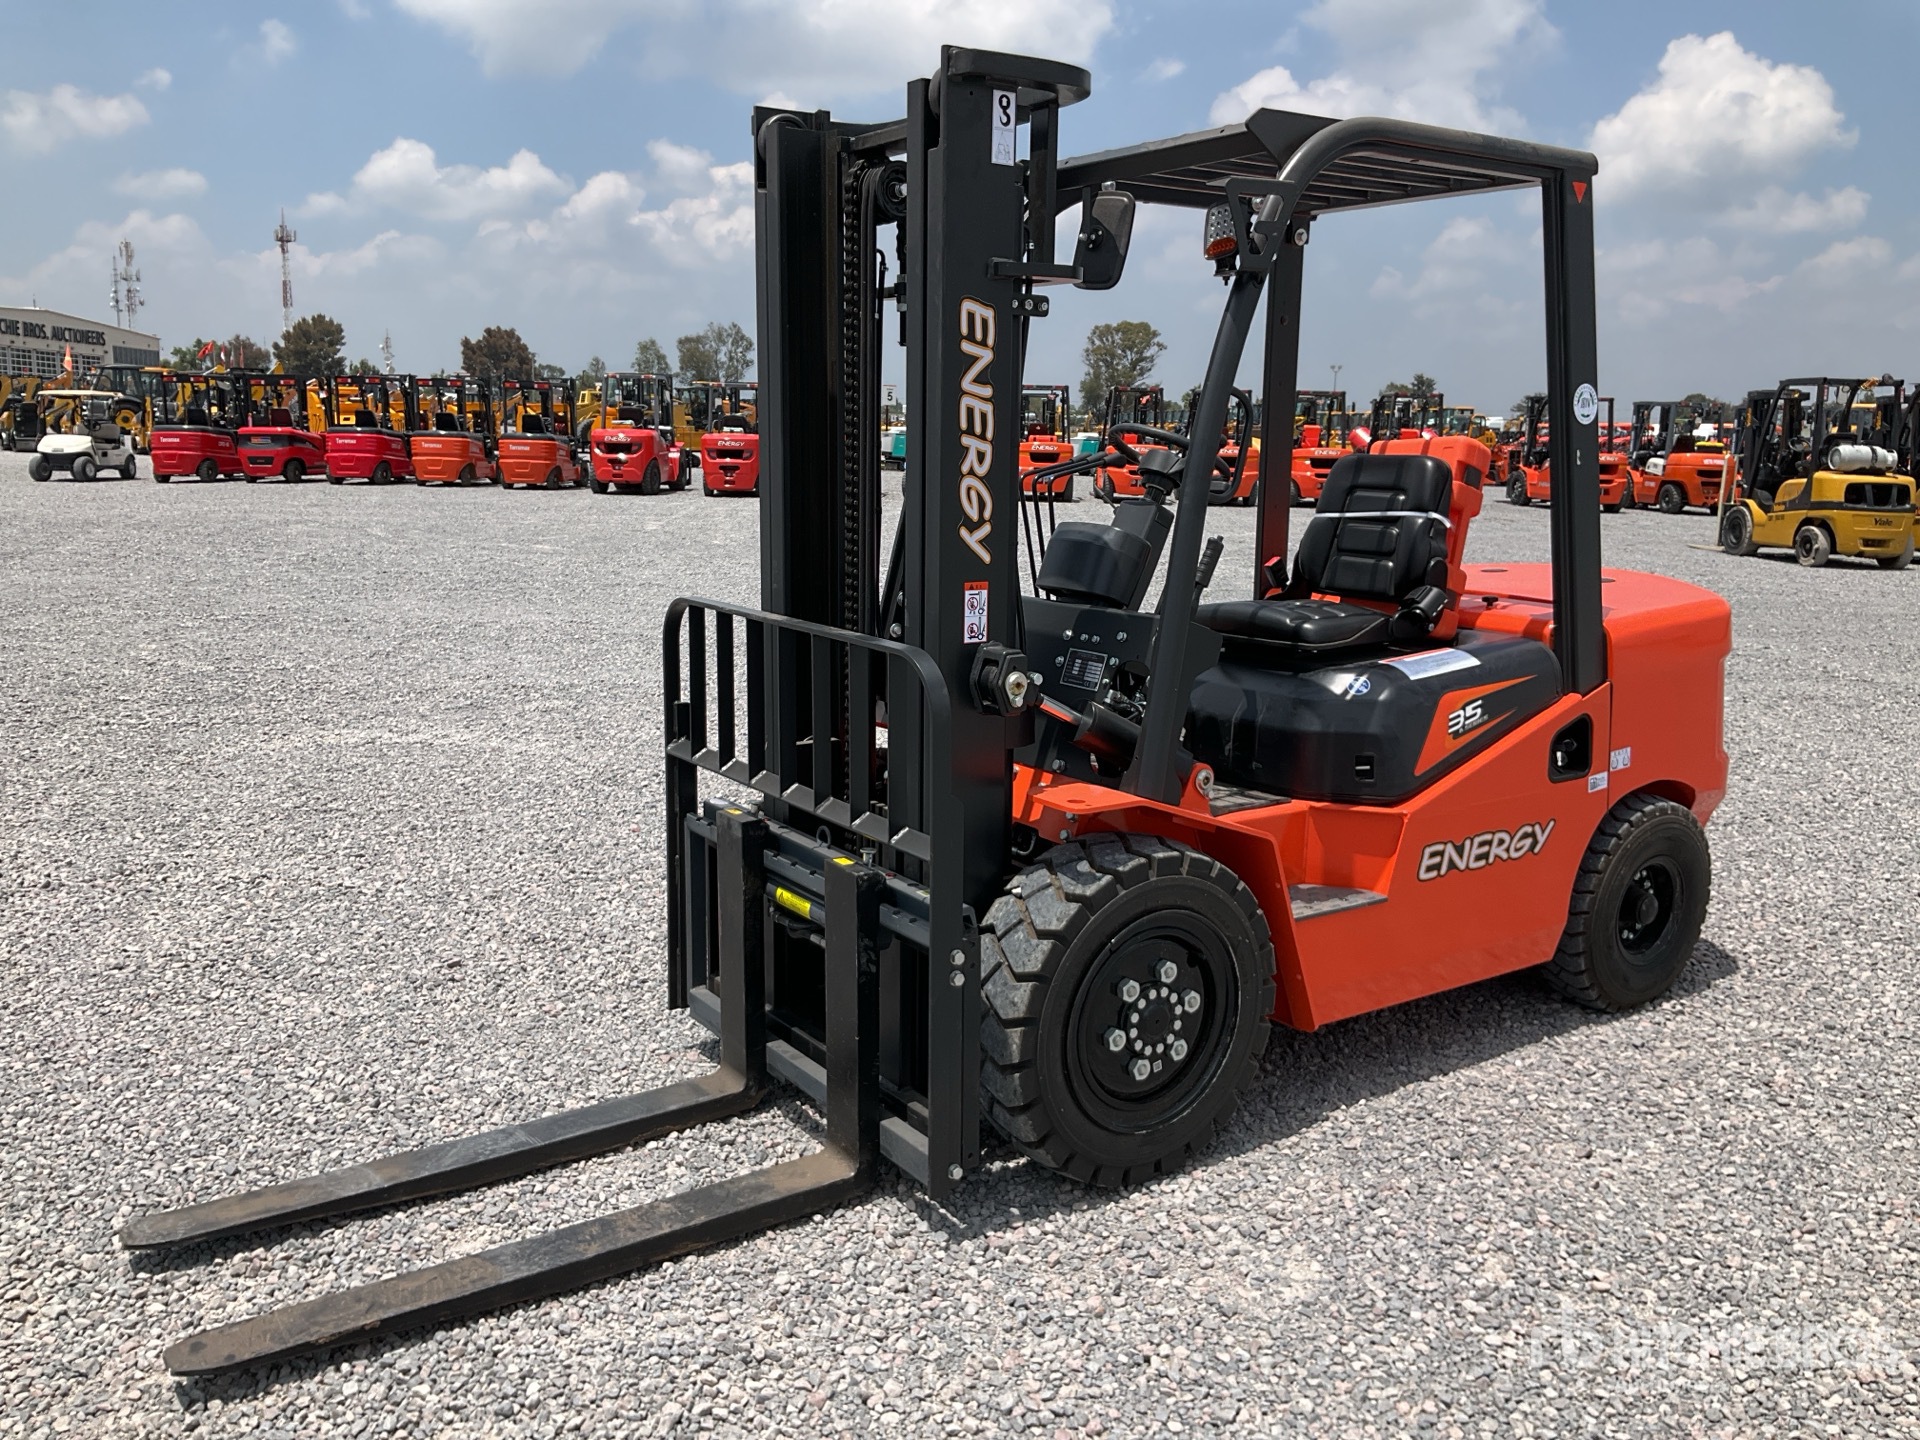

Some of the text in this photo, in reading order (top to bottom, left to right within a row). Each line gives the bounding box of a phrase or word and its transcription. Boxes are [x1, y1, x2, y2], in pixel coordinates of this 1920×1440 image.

[51, 325, 106, 346] AUCTIONEERS
[887, 391, 893, 401] 5
[959, 298, 995, 565] ENERGY
[1873, 517, 1893, 527] Yale
[1448, 699, 1482, 733] 35
[1417, 818, 1556, 881] ENERGY
